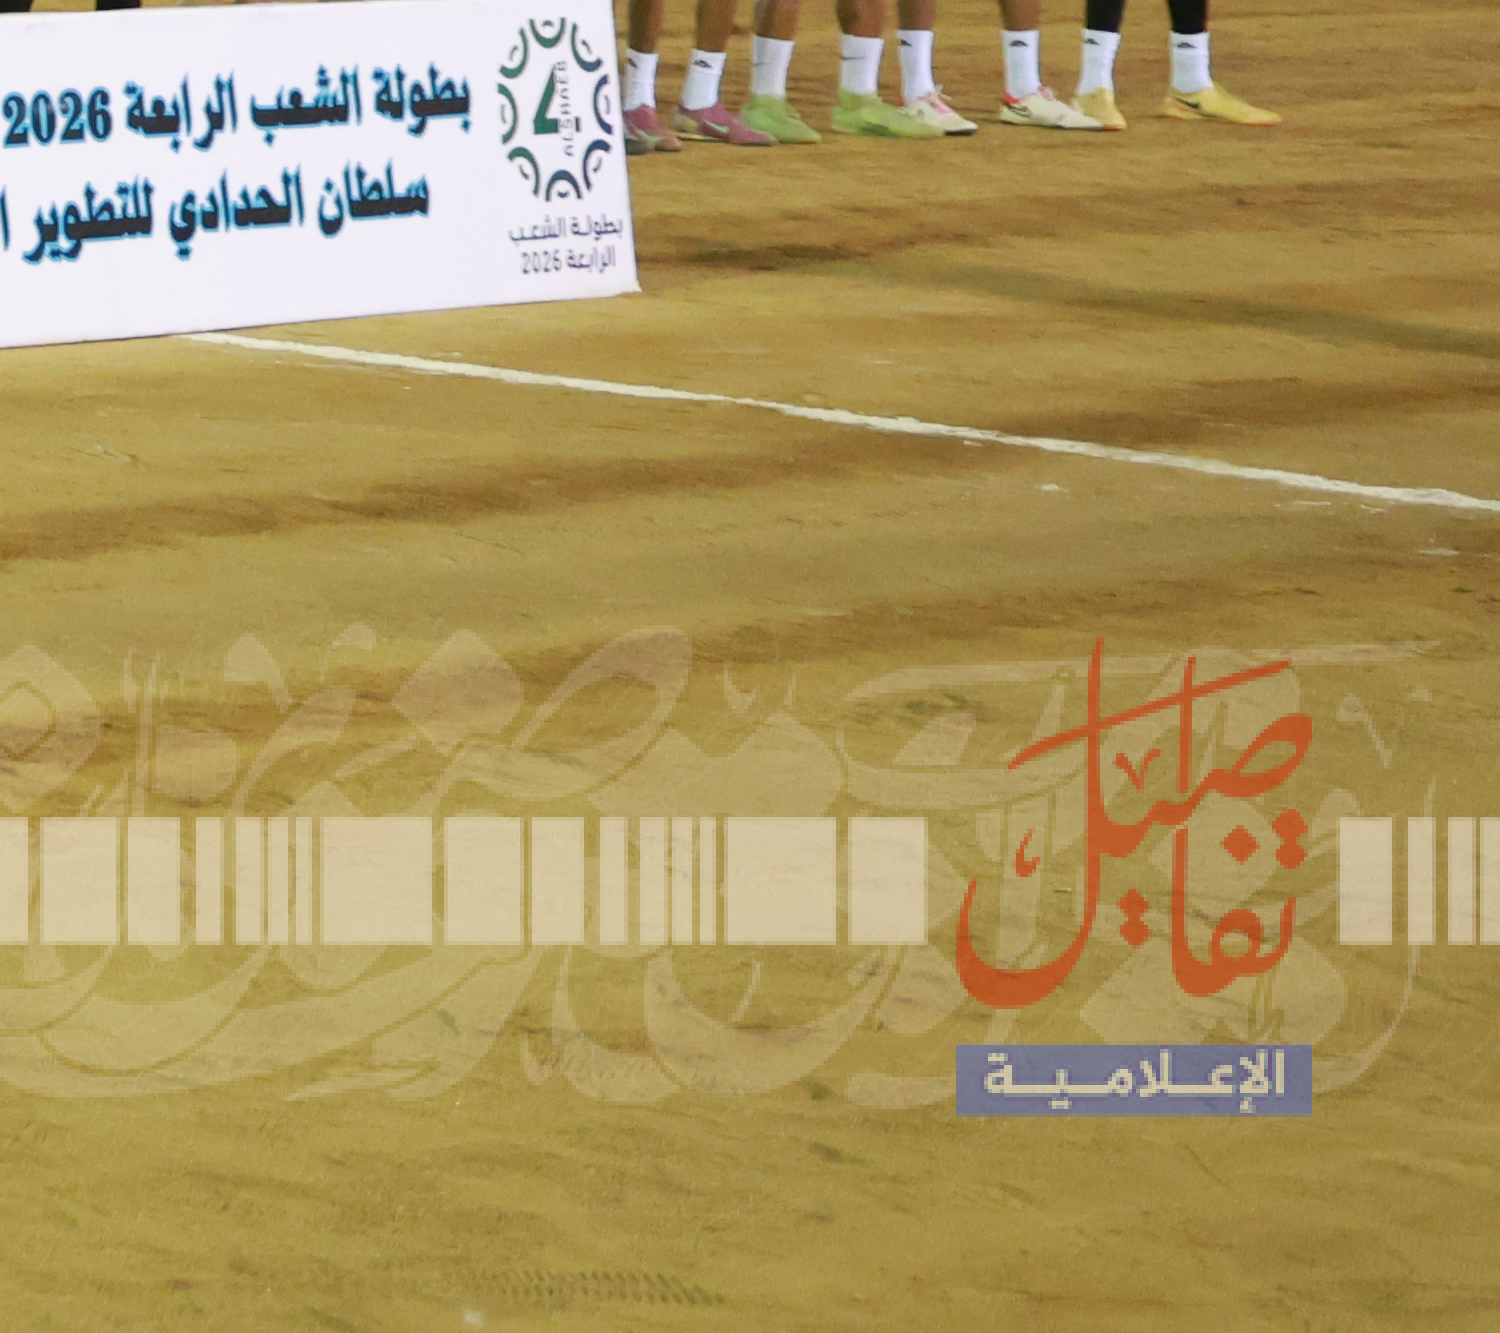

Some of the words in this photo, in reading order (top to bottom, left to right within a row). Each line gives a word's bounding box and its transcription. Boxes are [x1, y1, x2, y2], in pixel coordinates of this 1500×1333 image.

[2, 86, 112, 149] 2026
[122, 69, 238, 154] الرابعة
[250, 63, 361, 148] الشعب
[373, 61, 471, 137] بطولة
[22, 173, 154, 265] للتطوير
[168, 161, 305, 262] الحدادي
[317, 156, 430, 239] سلطان
[508, 214, 566, 246] الشعب
[571, 213, 623, 241] بطولة
[521, 250, 562, 275] 2026
[567, 245, 615, 273] الرابعة
